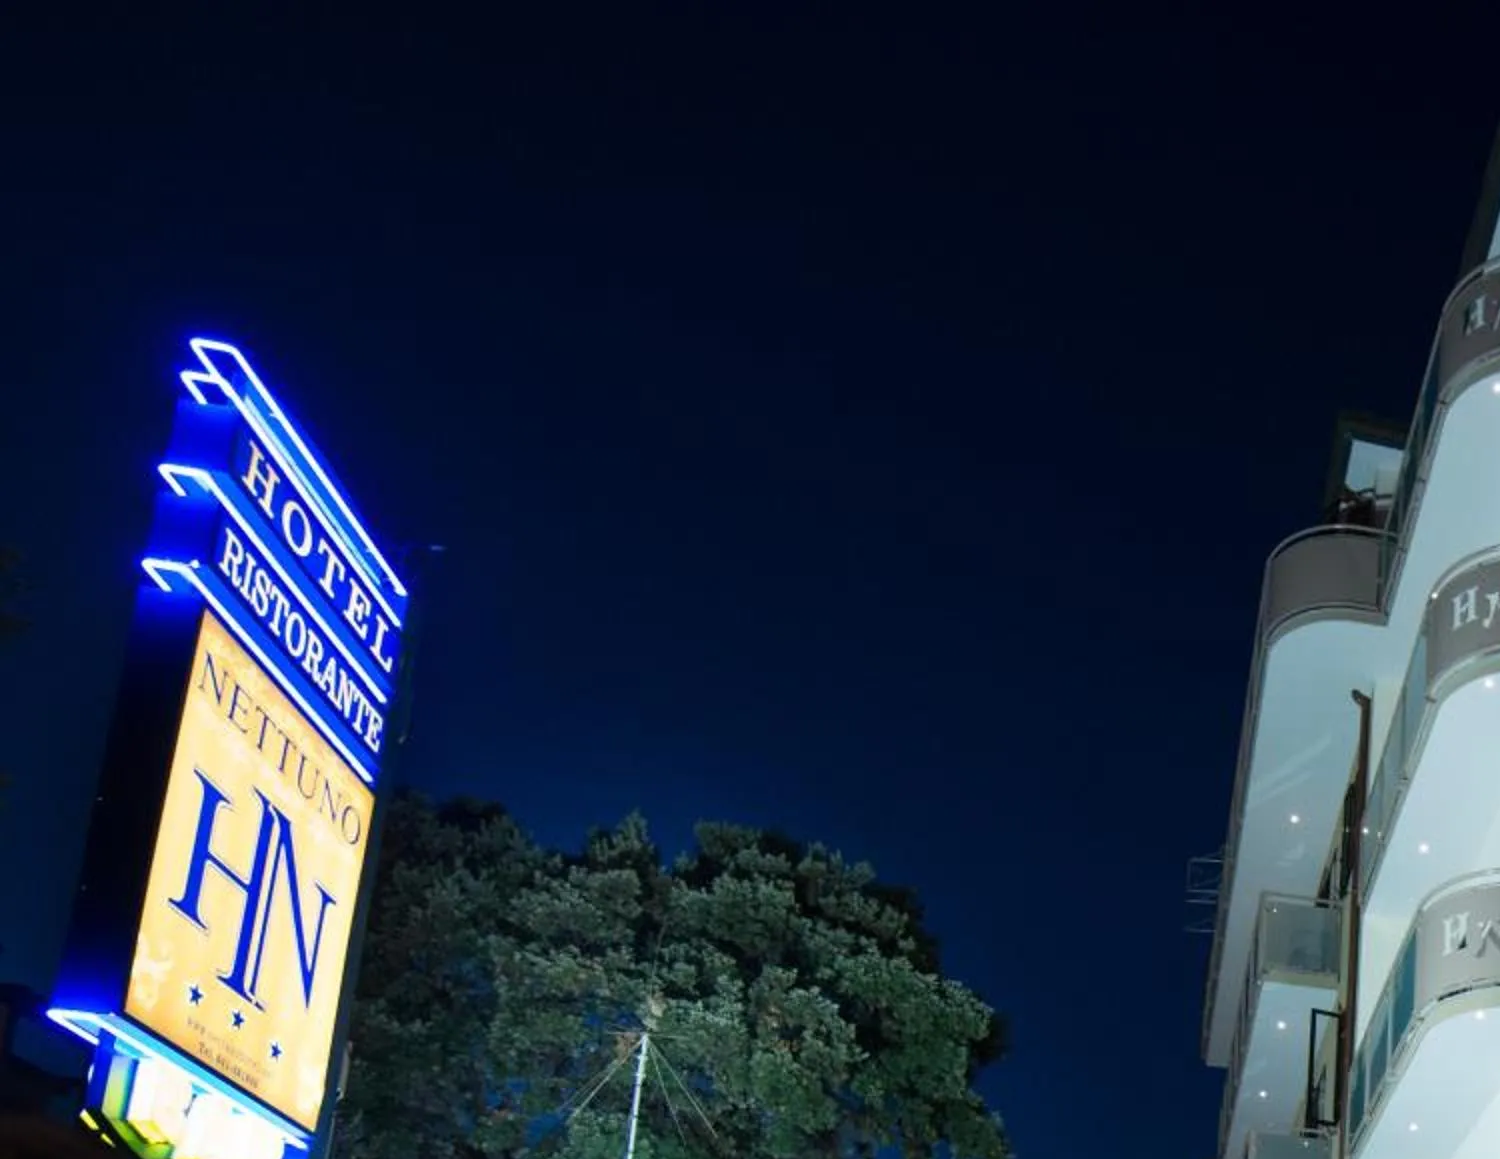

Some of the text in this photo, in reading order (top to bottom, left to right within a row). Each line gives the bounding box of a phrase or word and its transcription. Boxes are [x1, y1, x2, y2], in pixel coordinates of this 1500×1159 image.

[219, 528, 383, 751] RISTORANTE
[242, 441, 392, 672] HOTEL
[198, 652, 361, 845] NETTUNO
[168, 767, 337, 1012] HN
